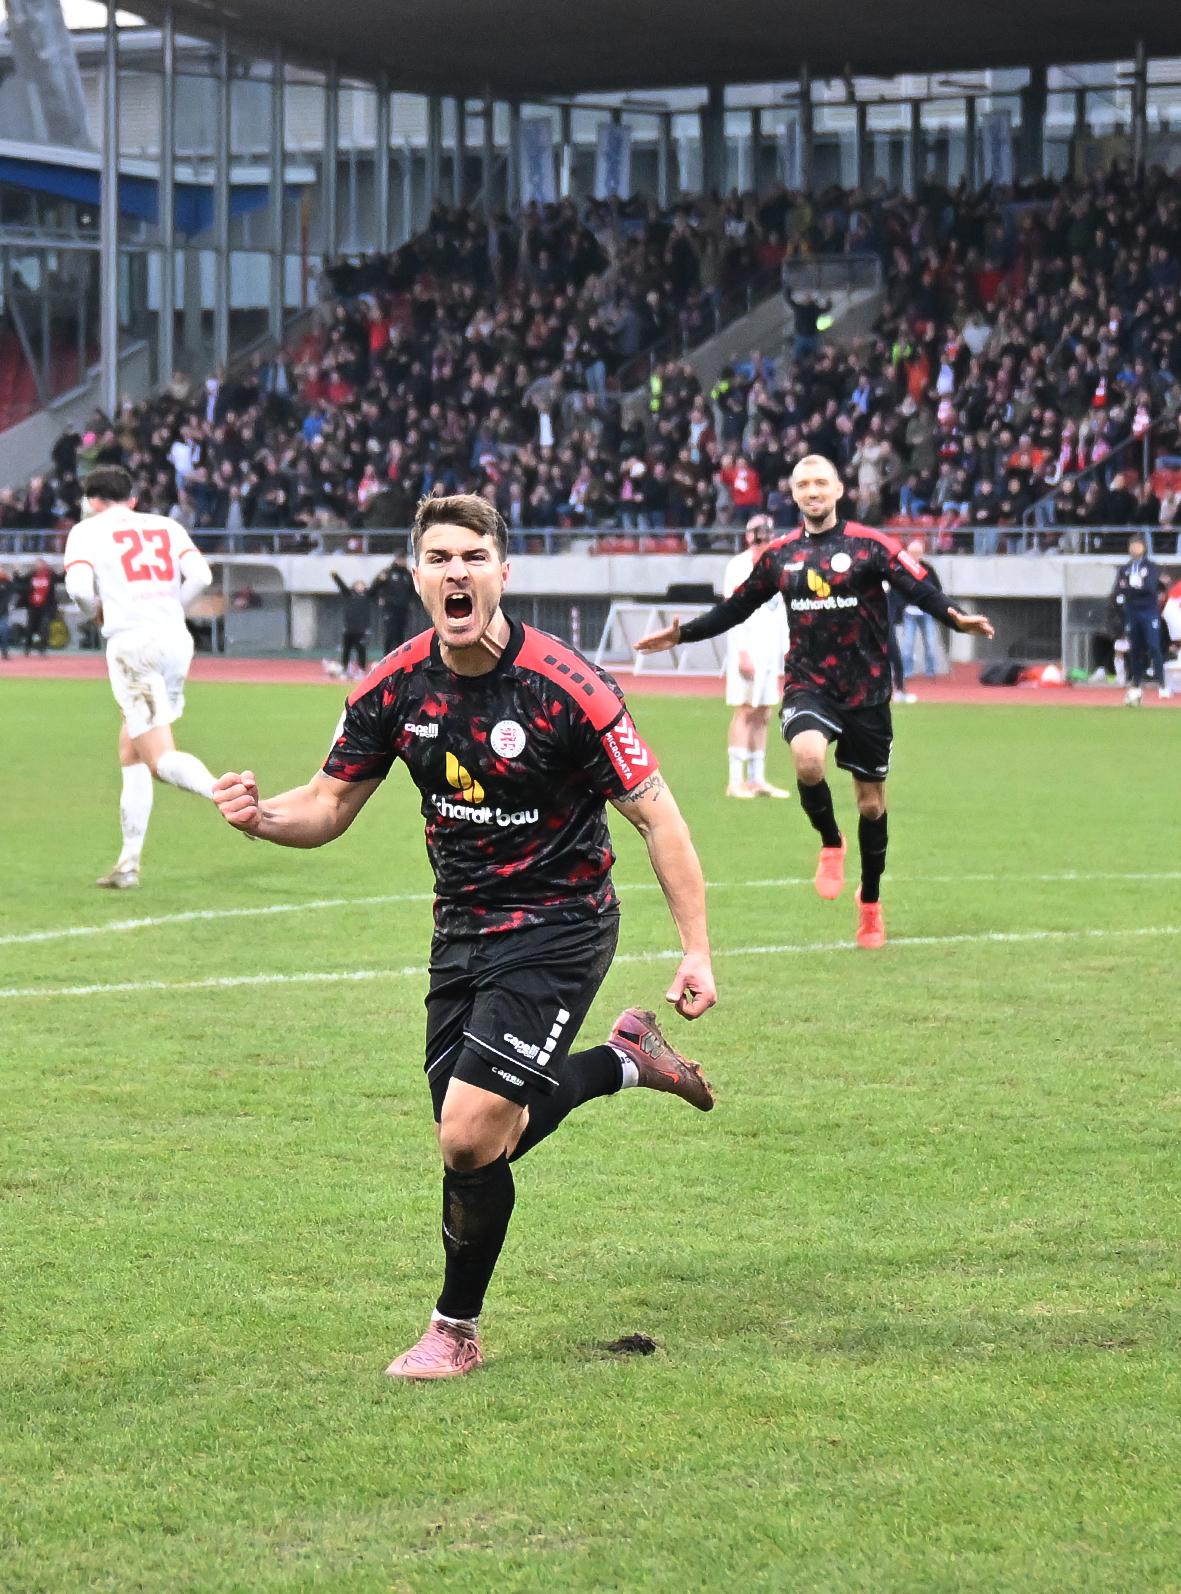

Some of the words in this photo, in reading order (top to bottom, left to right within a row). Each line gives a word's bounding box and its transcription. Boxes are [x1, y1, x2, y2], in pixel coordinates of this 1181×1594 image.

[112, 529, 174, 582] 23
[836, 596, 858, 609] bau
[405, 723, 438, 736] capelli
[605, 731, 633, 780] MICROMATA
[496, 808, 538, 827] bau
[504, 1033, 540, 1057] capelli
